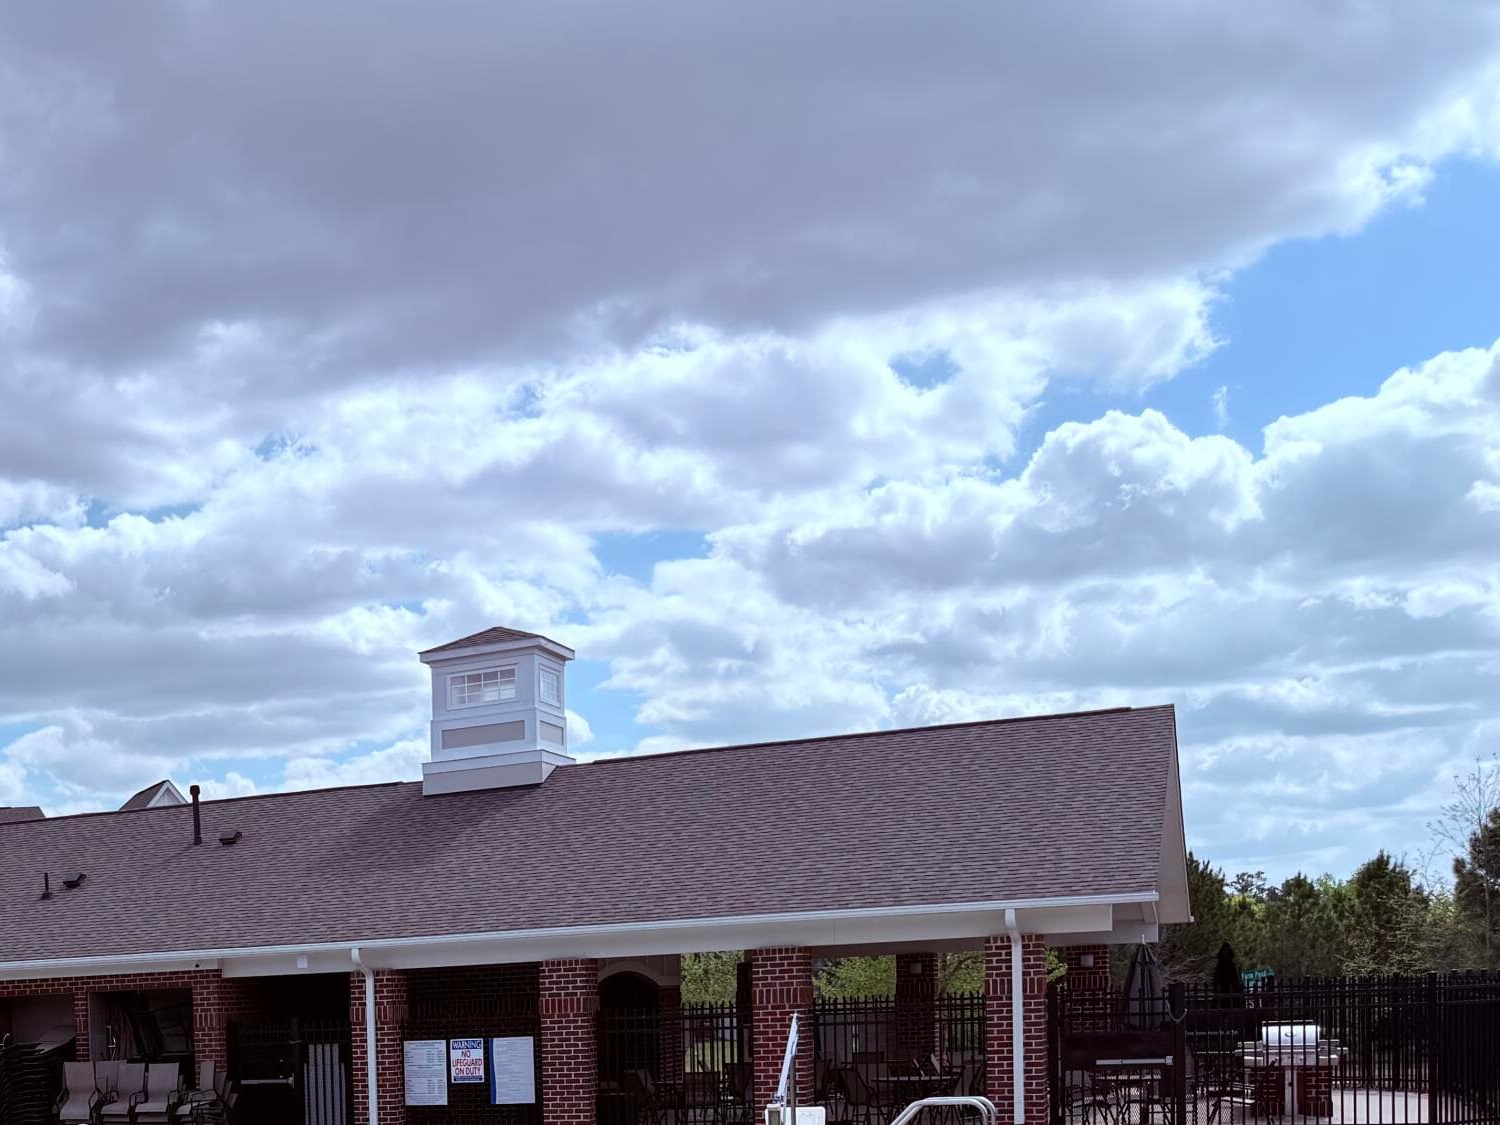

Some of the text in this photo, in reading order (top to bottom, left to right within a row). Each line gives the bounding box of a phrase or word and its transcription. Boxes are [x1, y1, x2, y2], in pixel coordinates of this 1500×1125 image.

[452, 1040, 482, 1049] WARNING
[461, 1050, 471, 1058] NO
[452, 1058, 482, 1067] LIFEGUARD
[466, 1067, 480, 1075] DUTY
